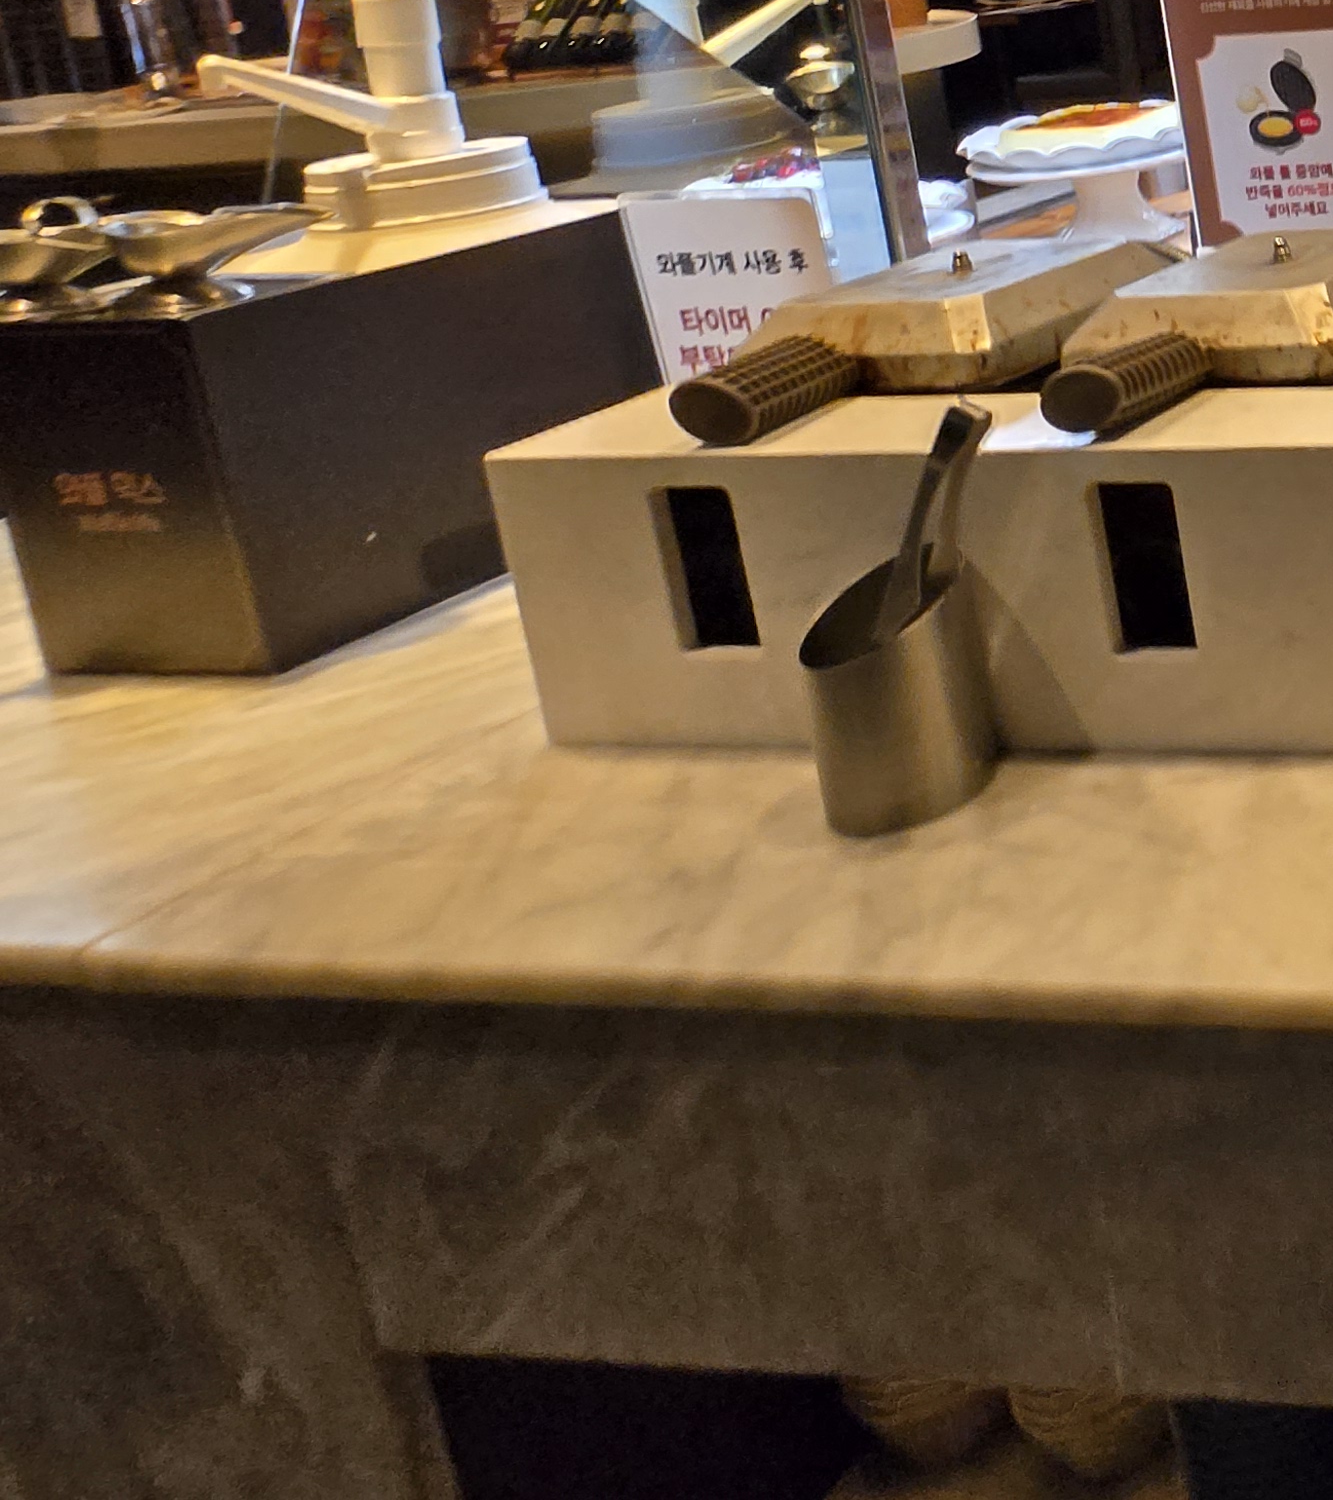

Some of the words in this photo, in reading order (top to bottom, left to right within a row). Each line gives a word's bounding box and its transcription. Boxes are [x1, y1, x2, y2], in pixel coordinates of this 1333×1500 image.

[1250, 164, 1275, 181] 와플
[1246, 185, 1283, 201] 반죽을
[1264, 201, 1329, 219] 넣어주세요
[657, 250, 737, 277] 와플기계
[744, 249, 782, 275] 사용
[788, 248, 808, 275] 후
[680, 306, 752, 336] 타이머
[680, 345, 734, 374] 부탁
